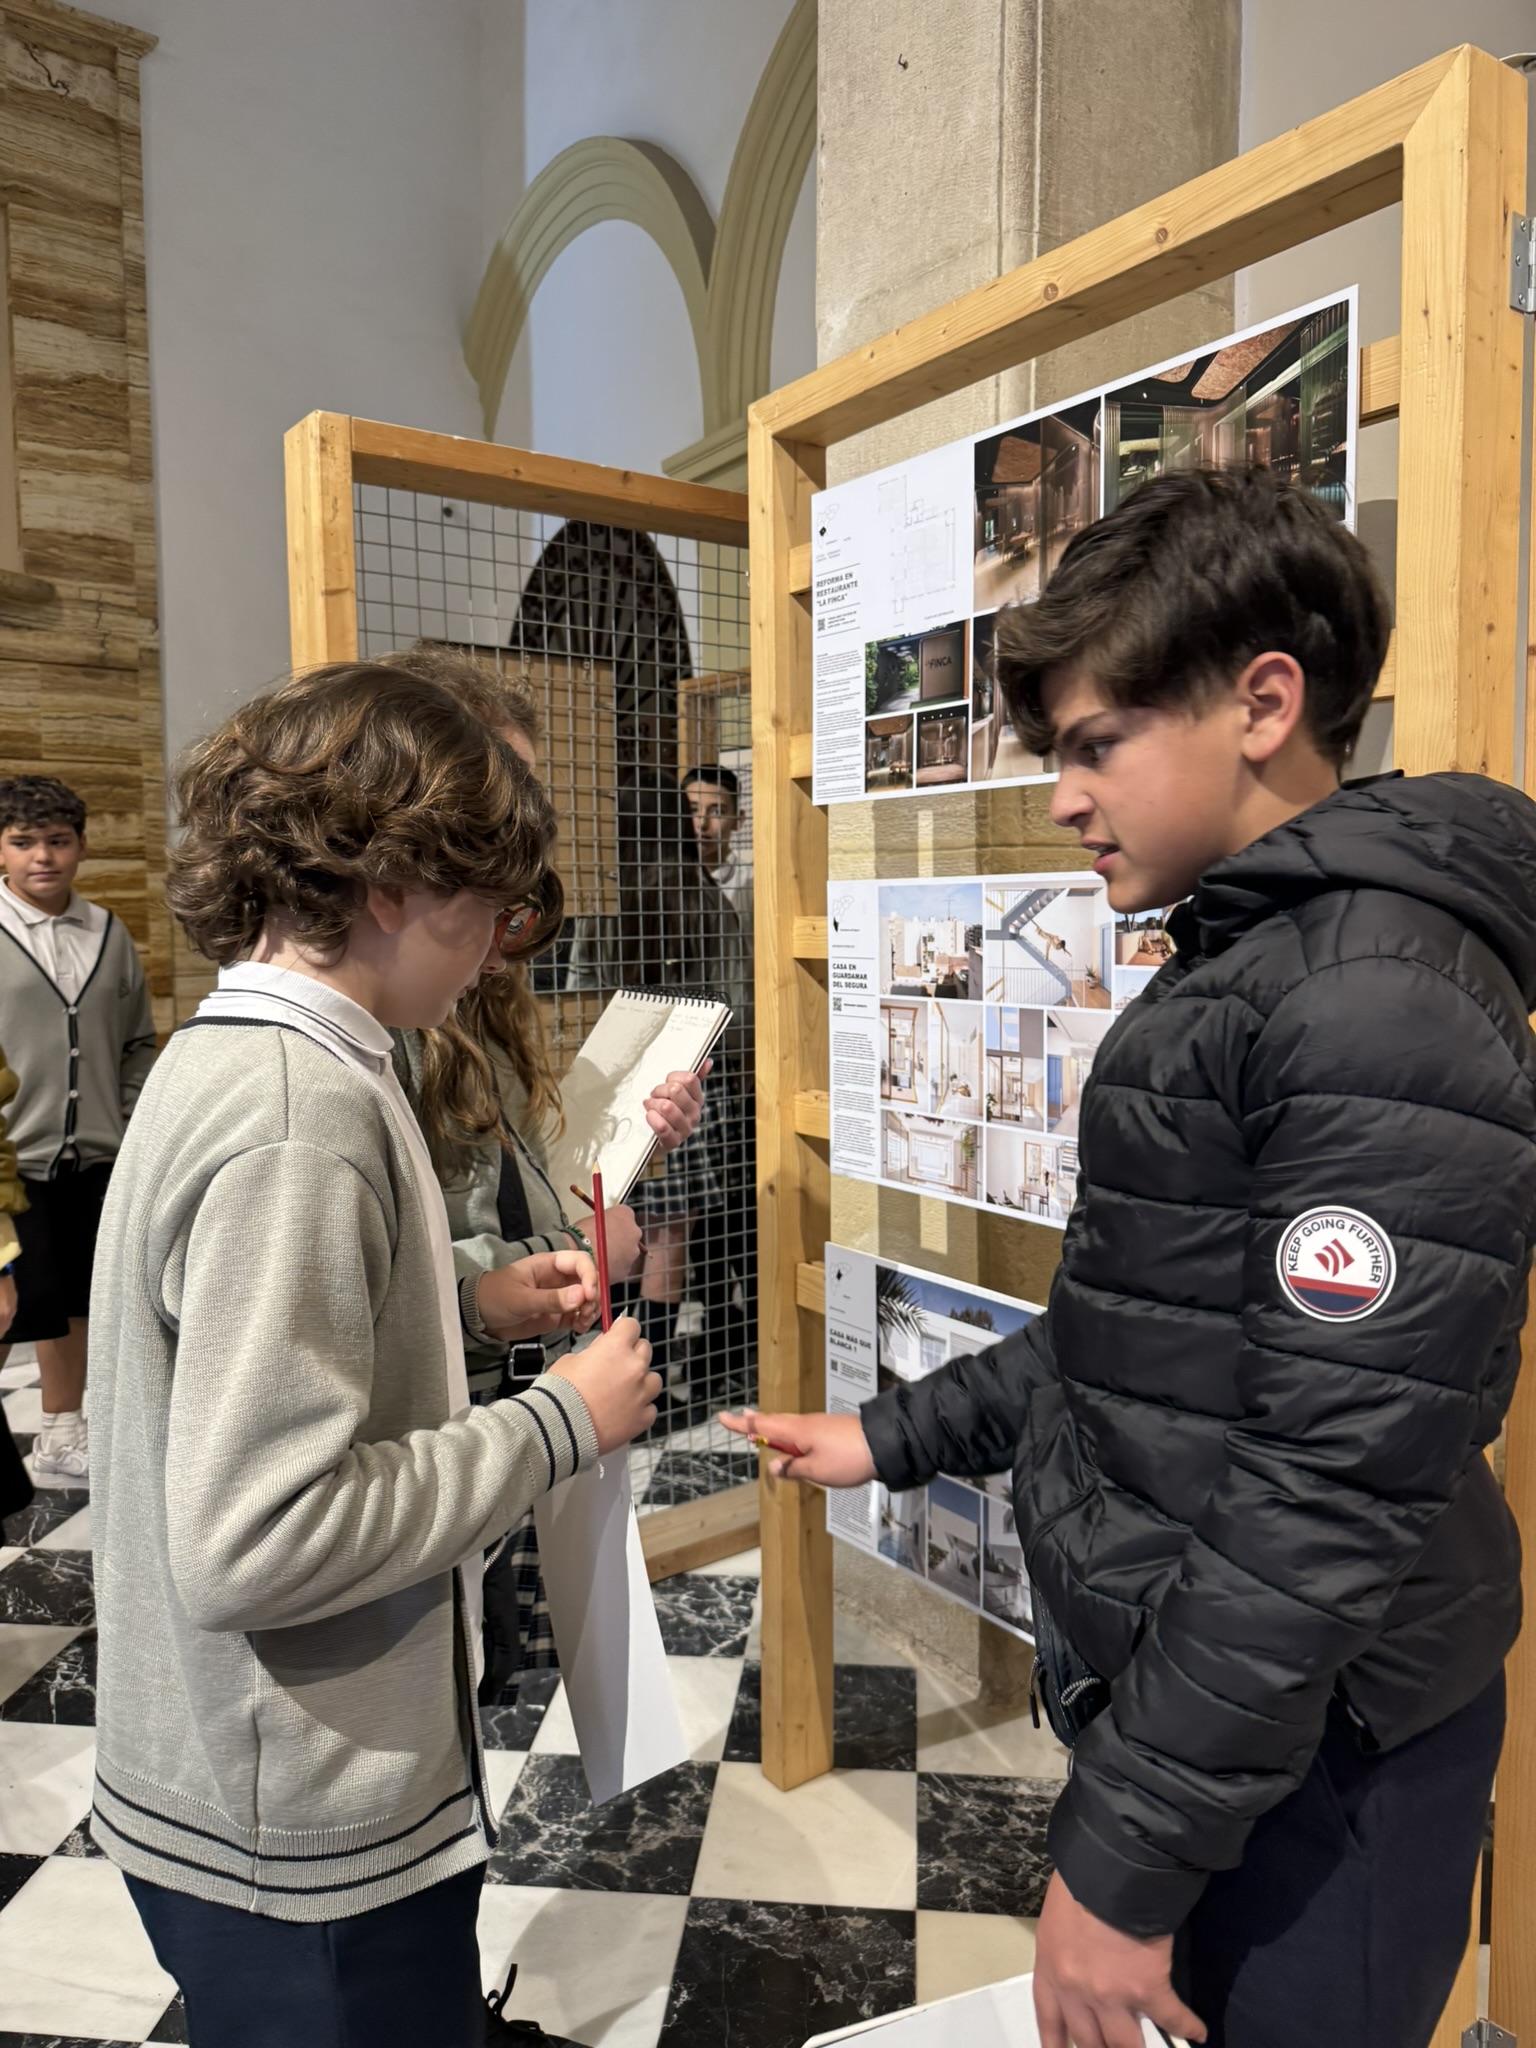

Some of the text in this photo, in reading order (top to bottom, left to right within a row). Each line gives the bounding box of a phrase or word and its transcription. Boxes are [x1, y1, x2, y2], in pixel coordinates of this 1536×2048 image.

[816, 572, 854, 588] REFORMA EN
[816, 580, 859, 598] RESTAURANTE
[930, 656, 952, 669] FINCA
[832, 972, 868, 980] GUARDAMAR
[832, 980, 844, 988] DEL
[1288, 1218, 1383, 1284] KEEP GOING FURTHER
[830, 1328, 846, 1339] CASA
[859, 1338, 872, 1350] QUE
[830, 1336, 852, 1350] BLANCA
